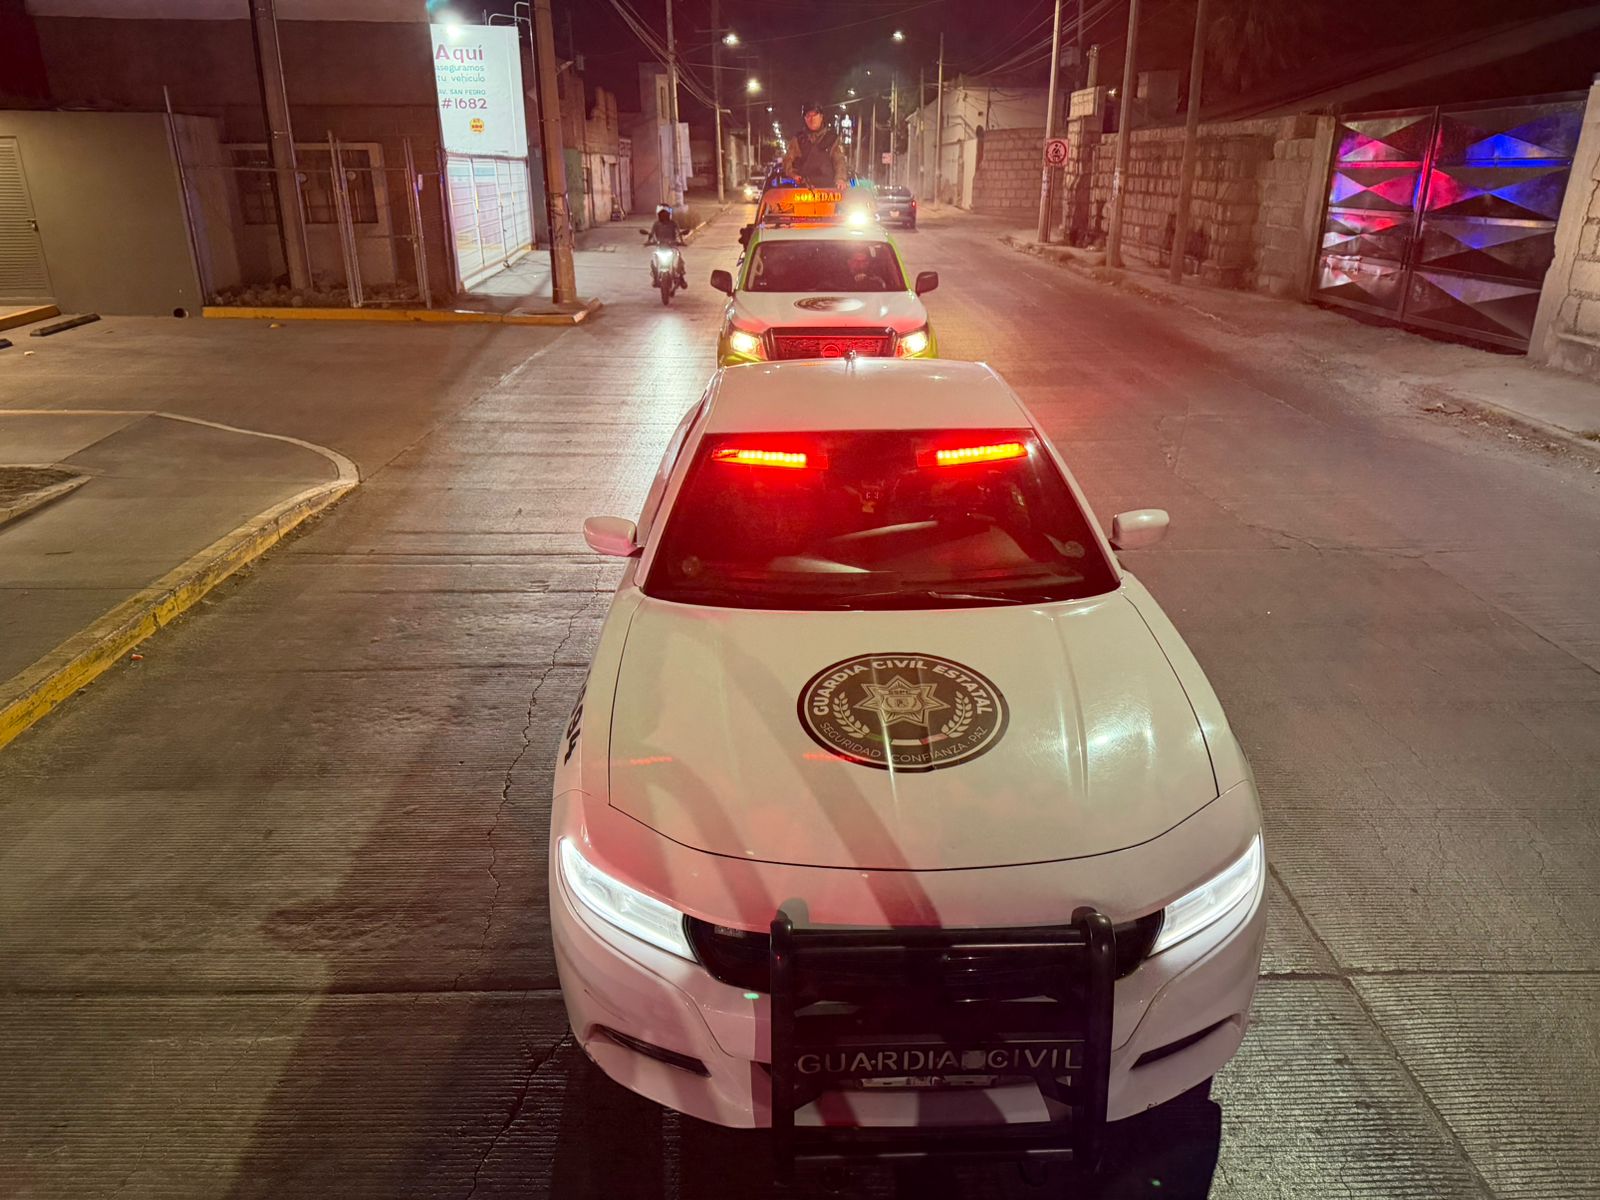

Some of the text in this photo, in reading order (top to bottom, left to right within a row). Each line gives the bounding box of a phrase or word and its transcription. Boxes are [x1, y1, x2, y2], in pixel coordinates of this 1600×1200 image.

[435, 44, 484, 63] Aquí
[441, 98, 487, 109] #1682
[794, 192, 842, 202] SOLEDAD
[812, 659, 993, 716] GUARDIA CIVIL ESTATAL
[819, 722, 988, 762] SEGURIDAD CONFIANZA PAZ
[797, 1049, 1082, 1073] GUARDIA CIVIL
